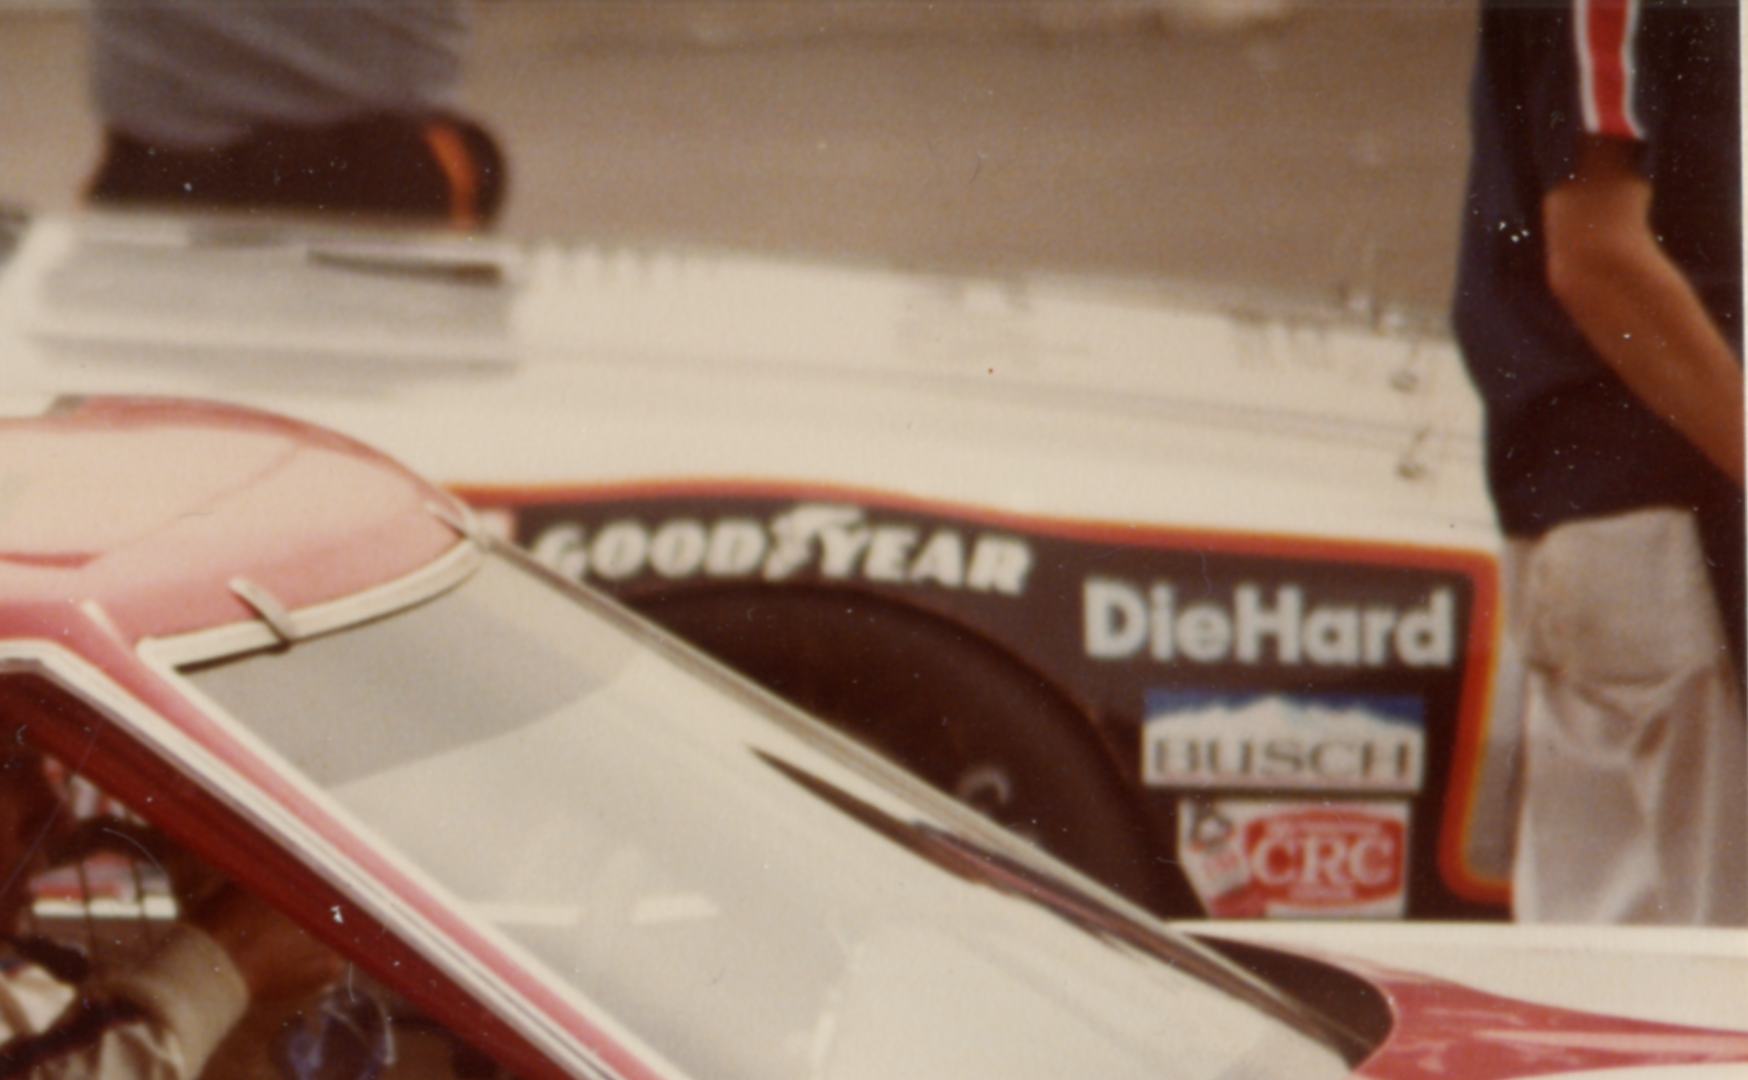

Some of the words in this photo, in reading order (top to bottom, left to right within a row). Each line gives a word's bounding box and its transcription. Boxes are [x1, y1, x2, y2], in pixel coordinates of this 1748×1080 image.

[533, 505, 1033, 594] GOODYEAR
[1083, 578, 1452, 666] DieHard
[1154, 736, 1412, 782] BUSCH
[1252, 834, 1395, 888] CRC
